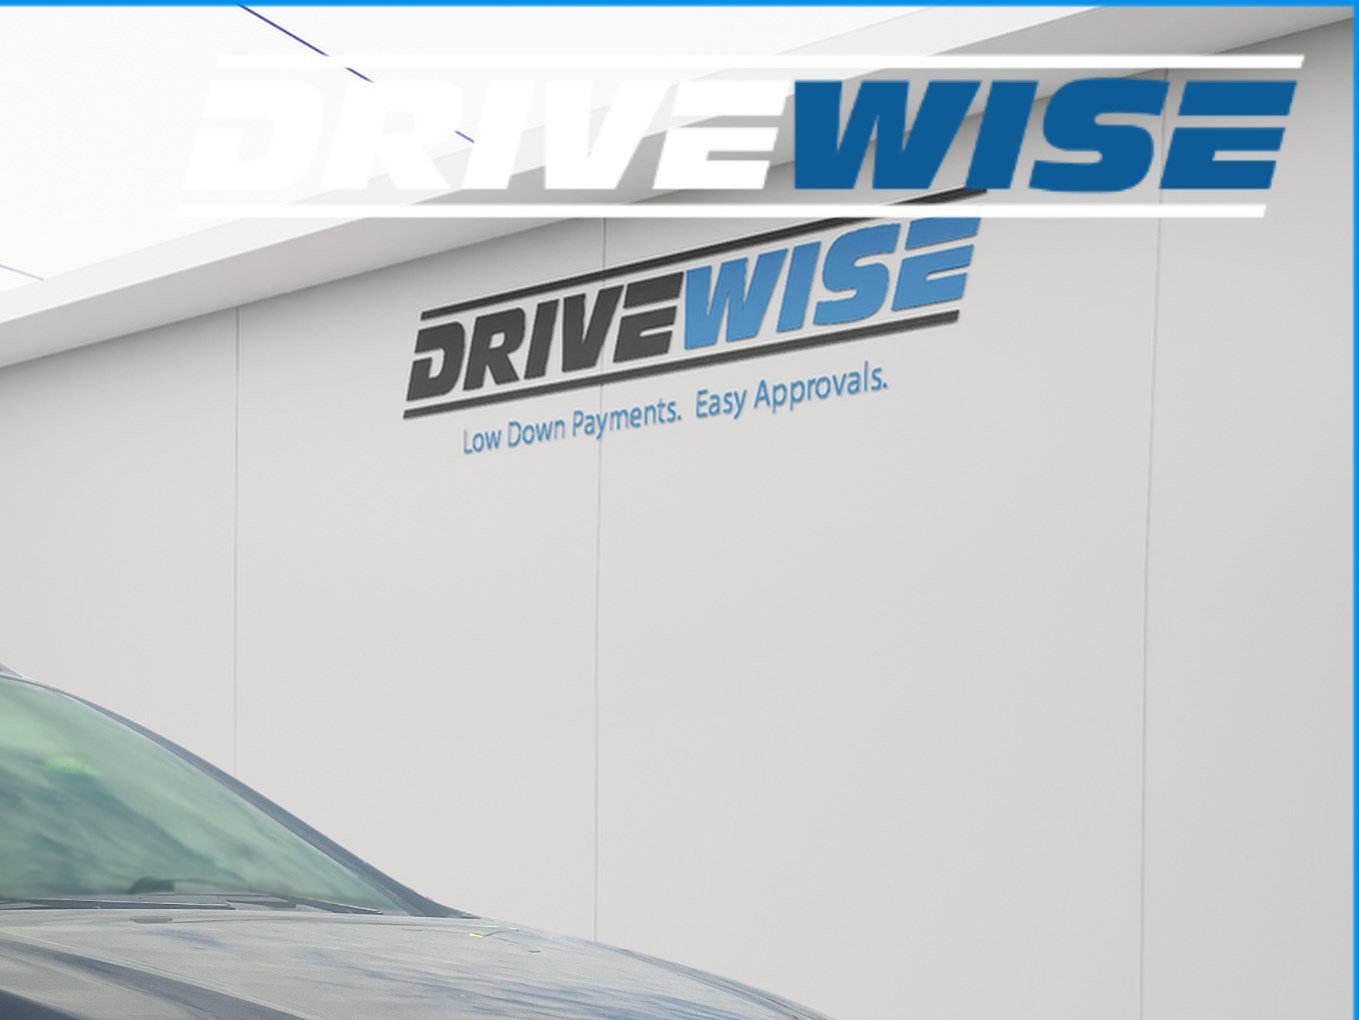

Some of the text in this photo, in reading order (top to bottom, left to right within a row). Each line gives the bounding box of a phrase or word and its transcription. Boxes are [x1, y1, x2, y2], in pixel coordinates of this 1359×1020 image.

[406, 216, 982, 402] DRIVEWISE
[463, 360, 889, 455] Low Down Payments. Easy Approvals.
